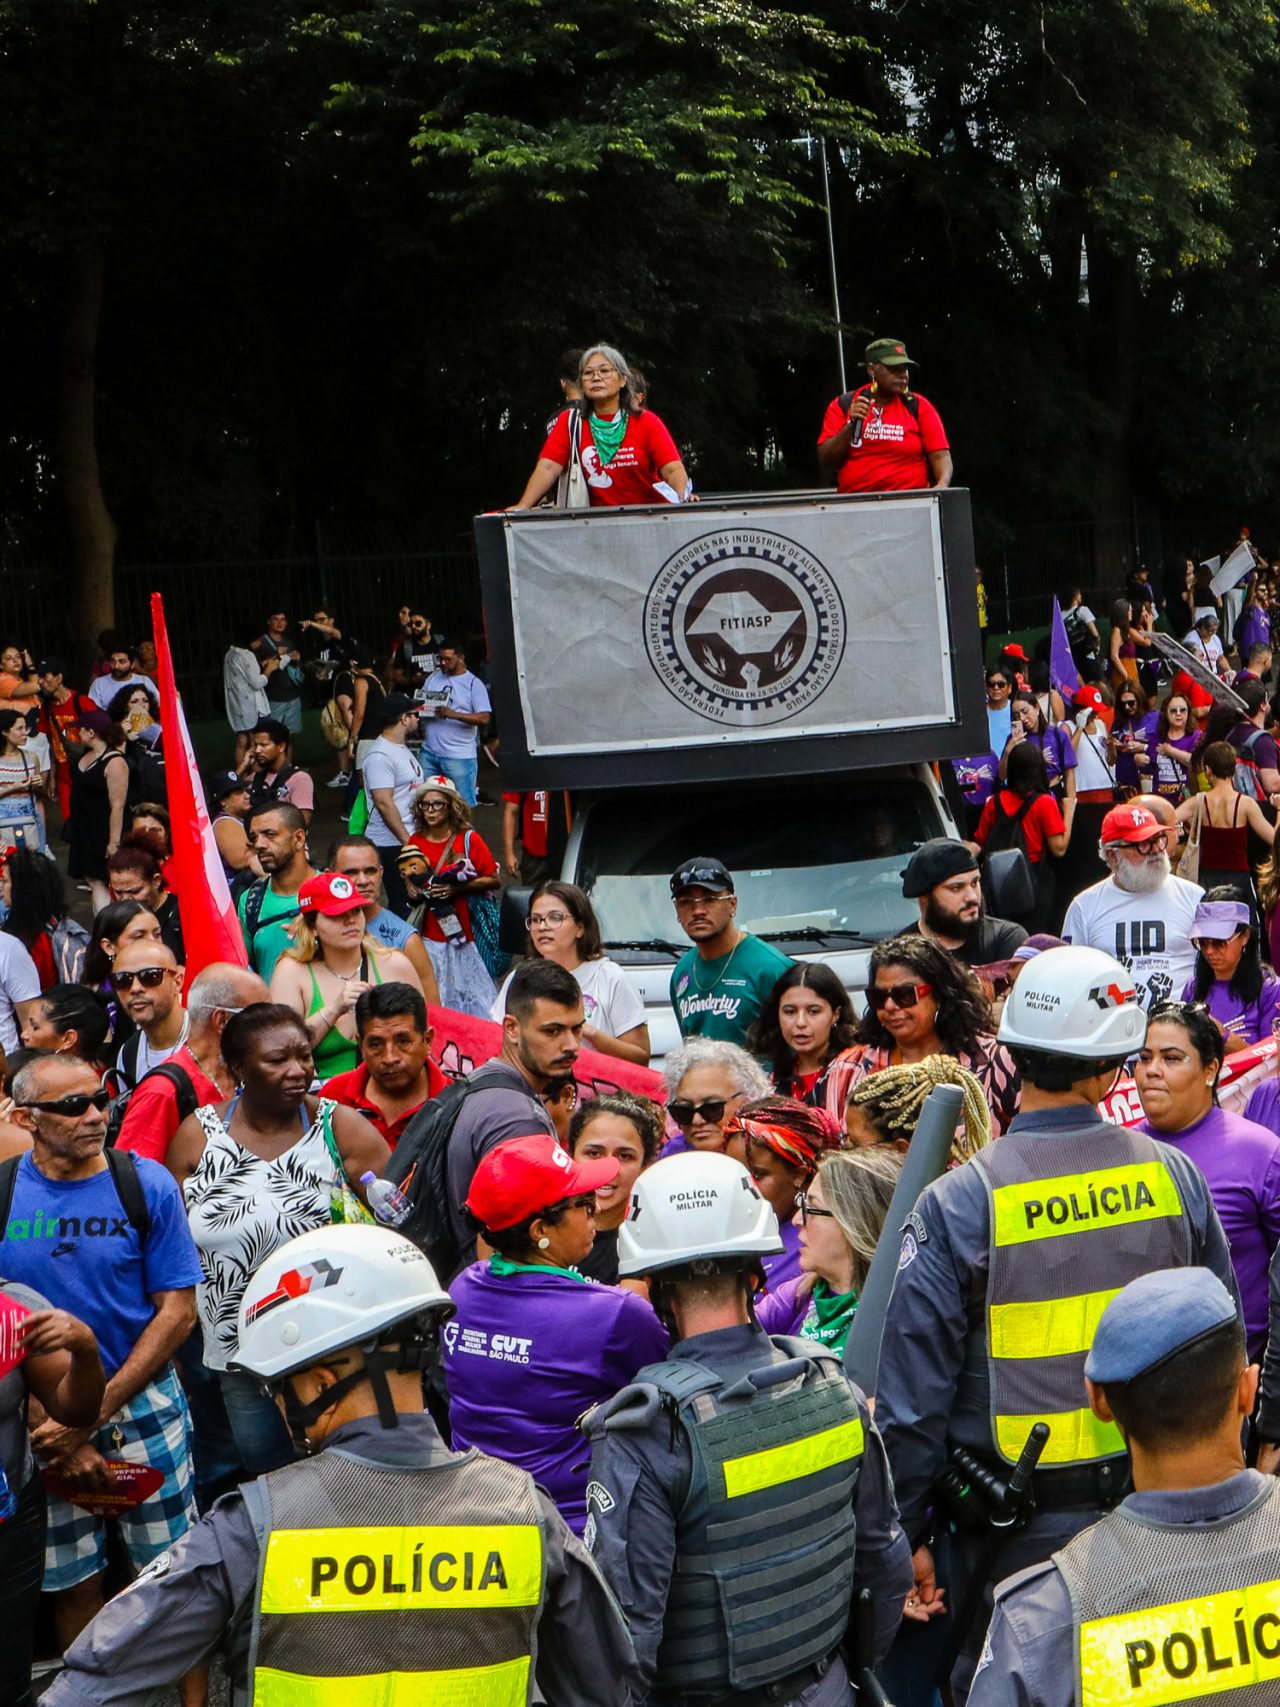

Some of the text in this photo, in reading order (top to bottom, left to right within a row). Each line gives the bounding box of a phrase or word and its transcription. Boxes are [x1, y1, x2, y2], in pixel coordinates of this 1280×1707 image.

[865, 427, 904, 436] Mulheres
[712, 534, 730, 548] NAS
[788, 548, 800, 561] DE
[656, 543, 710, 601] TRABALHADORES
[720, 615, 773, 630] FITIASP
[831, 613, 839, 626] DO
[825, 629, 840, 662] ESTADO
[650, 621, 678, 688] INDEPENDENTE
[820, 663, 831, 676] DE
[712, 682, 745, 698] FUNDADA
[746, 690, 756, 698] EM
[811, 675, 826, 692] SÃO
[678, 685, 725, 717] FEDERAÇÃO
[786, 690, 812, 711] PAULO
[1024, 989, 1061, 1005] POLÍCIA
[1026, 1001, 1054, 1012] MILITAR
[669, 1188, 718, 1204] POLÍCIA
[676, 1200, 713, 1211] MILITAR
[1024, 1181, 1156, 1229] POLÍCIA
[489, 1350, 530, 1364] SÃO PAULO
[311, 1542, 508, 1597] POLÍCIA
